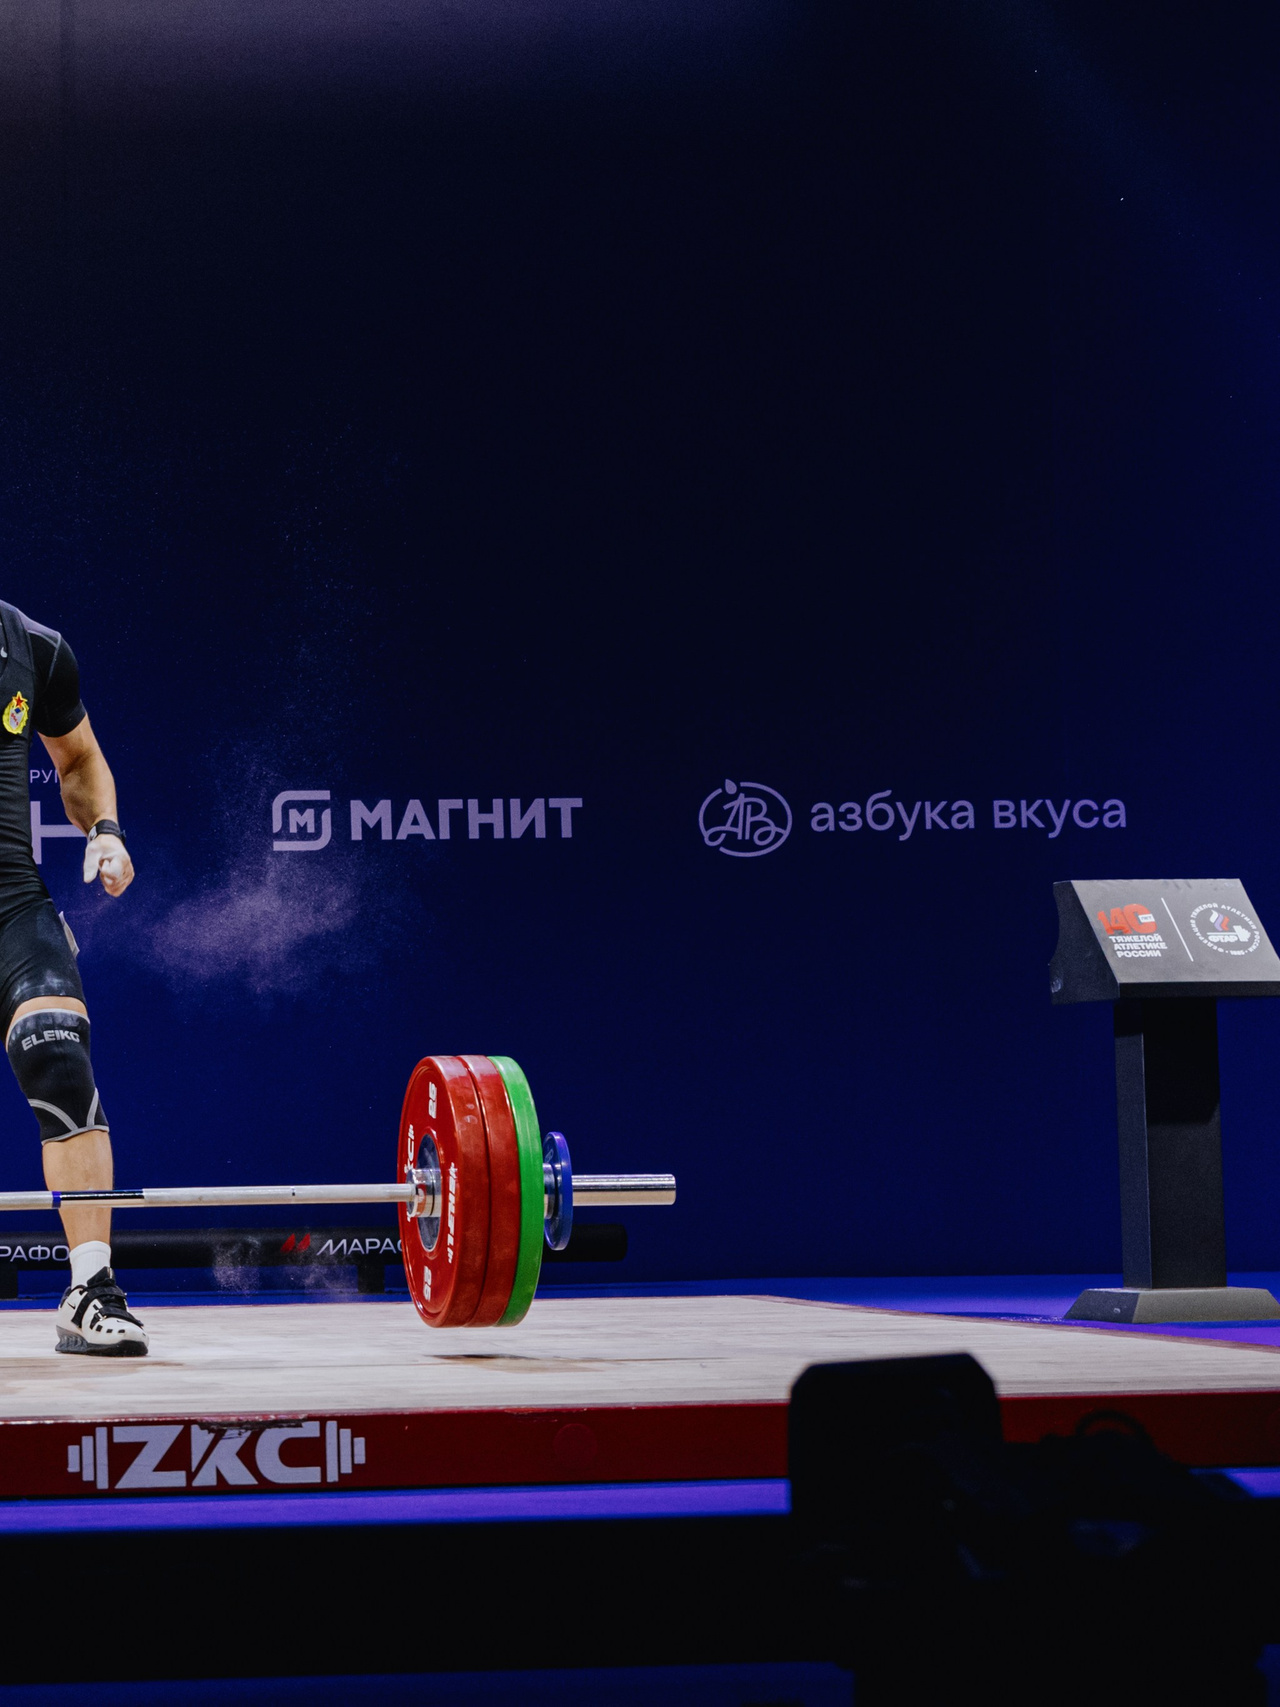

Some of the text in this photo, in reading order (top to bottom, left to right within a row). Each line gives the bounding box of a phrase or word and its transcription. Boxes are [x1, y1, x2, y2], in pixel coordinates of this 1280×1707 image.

[350, 798, 583, 840] МАГНИТ
[810, 790, 1127, 842] азбука вкуса
[1108, 933, 1164, 943] ТЯЖЕЛОЙ
[1113, 942, 1168, 951] АТЛЕТИКЕ
[1116, 950, 1162, 958] РОССИИ
[112, 1421, 322, 1489] ZKC
